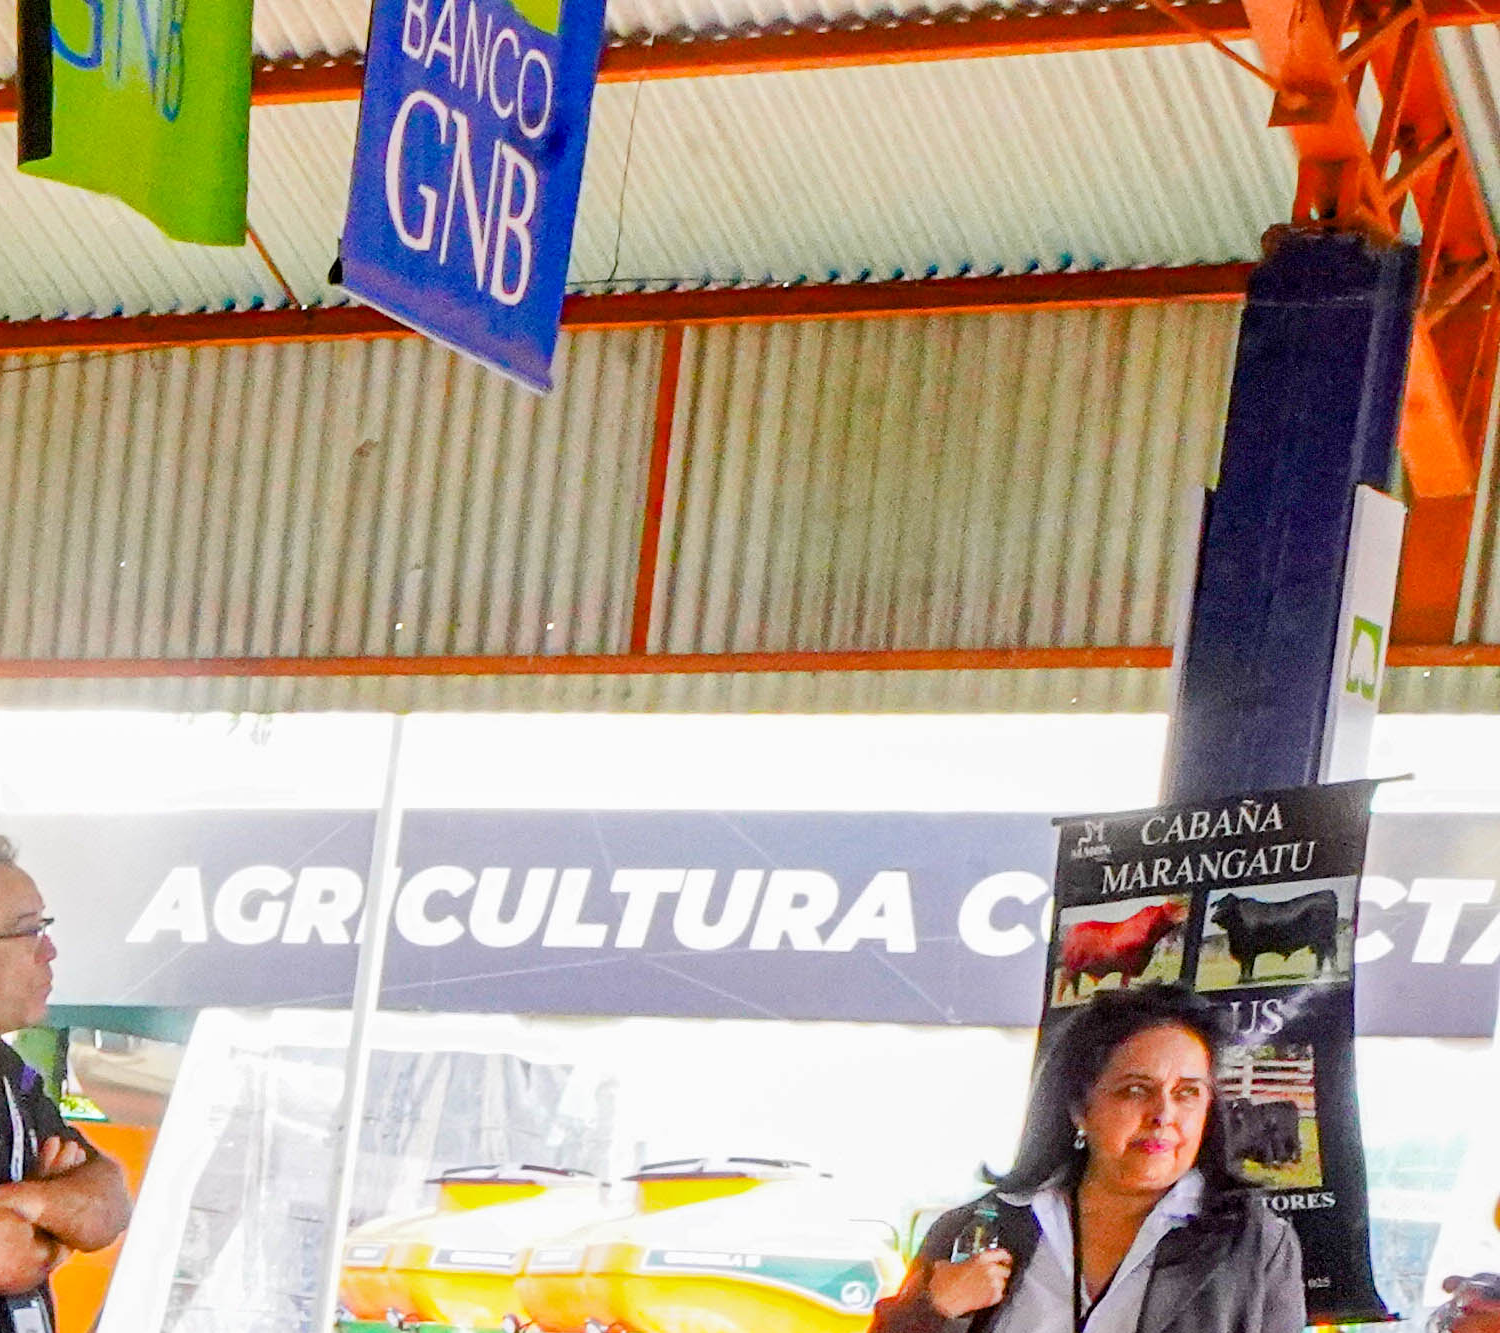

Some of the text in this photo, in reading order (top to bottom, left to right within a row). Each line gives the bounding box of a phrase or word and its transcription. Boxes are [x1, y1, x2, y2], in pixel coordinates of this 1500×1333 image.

[401, 0, 553, 139] BANCO
[385, 89, 538, 306] GNB
[1100, 840, 1316, 895] MARANGATU
[1141, 799, 1284, 846] CABAÑA
[125, 864, 917, 956] AGRCULTURA
